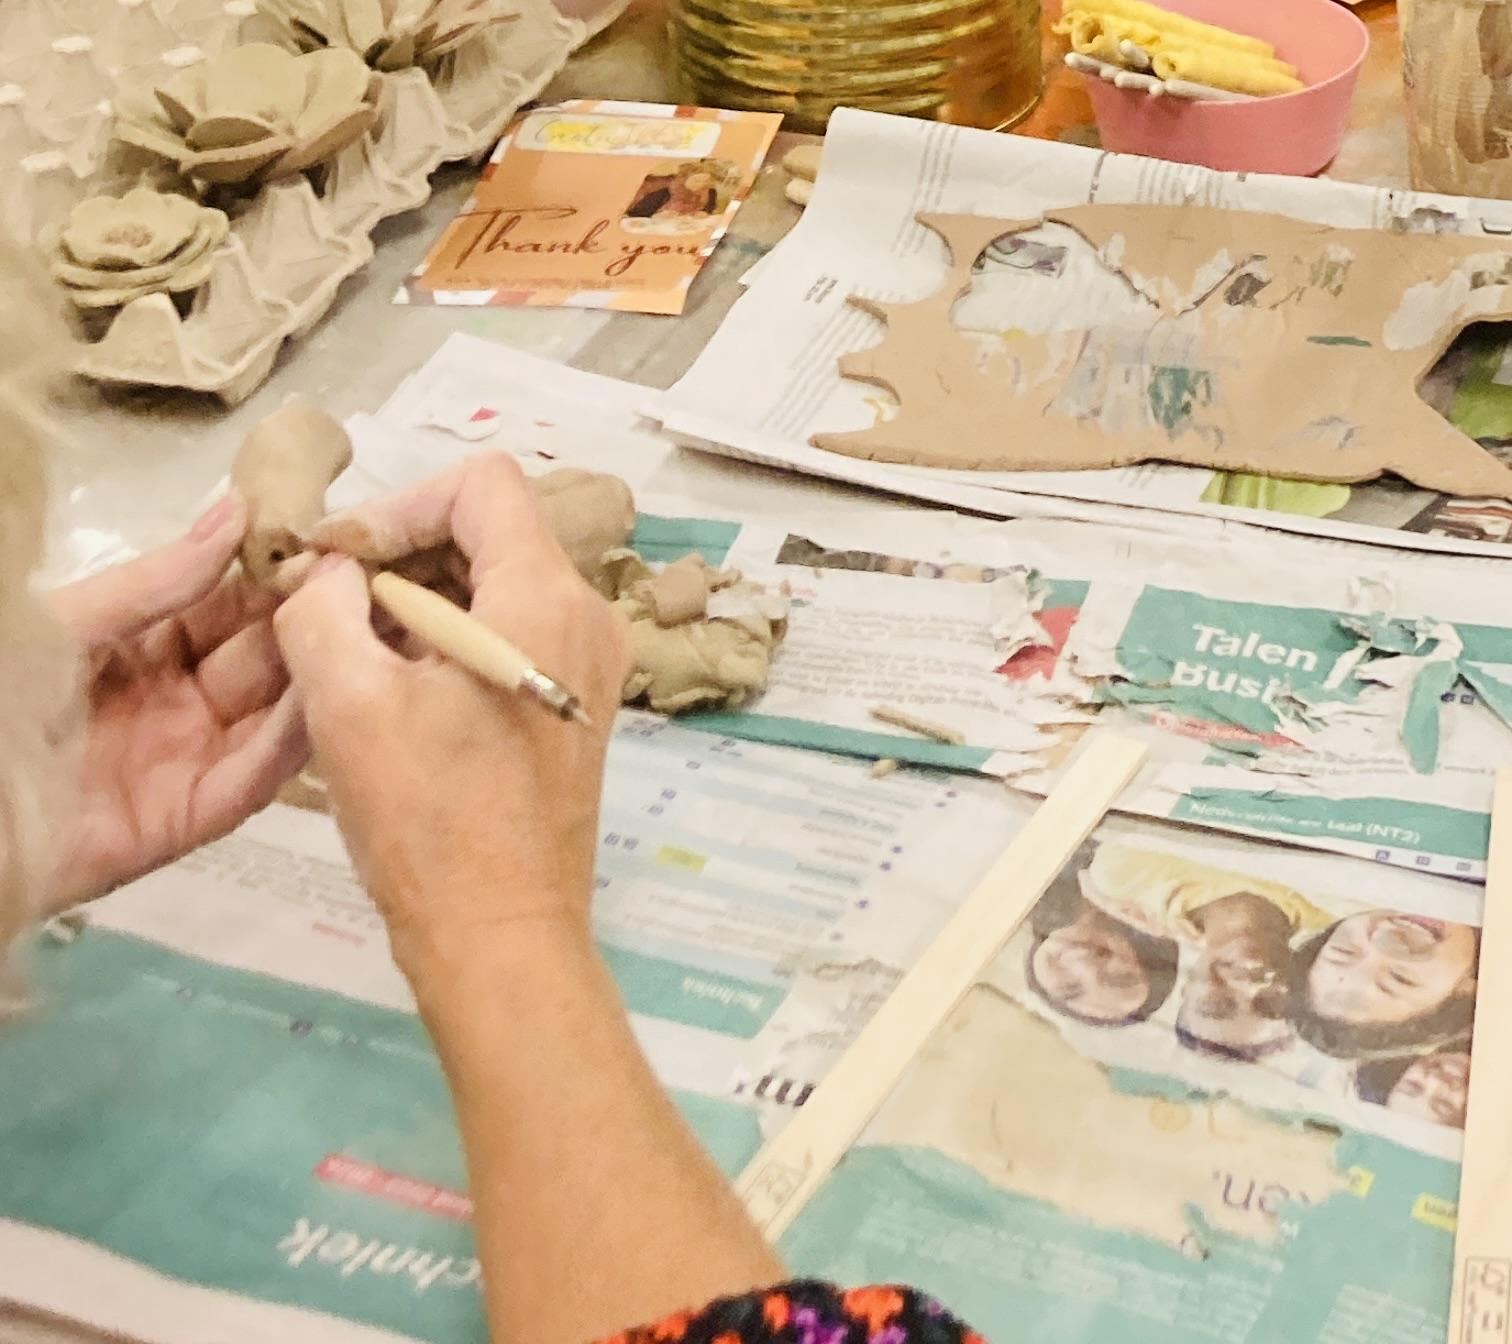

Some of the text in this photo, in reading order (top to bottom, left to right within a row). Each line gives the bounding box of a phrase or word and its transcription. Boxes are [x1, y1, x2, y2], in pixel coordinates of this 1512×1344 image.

[453, 206, 702, 277] Thank you
[1192, 623, 1319, 673] Talen
[1365, 820, 1422, 846] (NT2)
[276, 1217, 485, 1292] chniek
